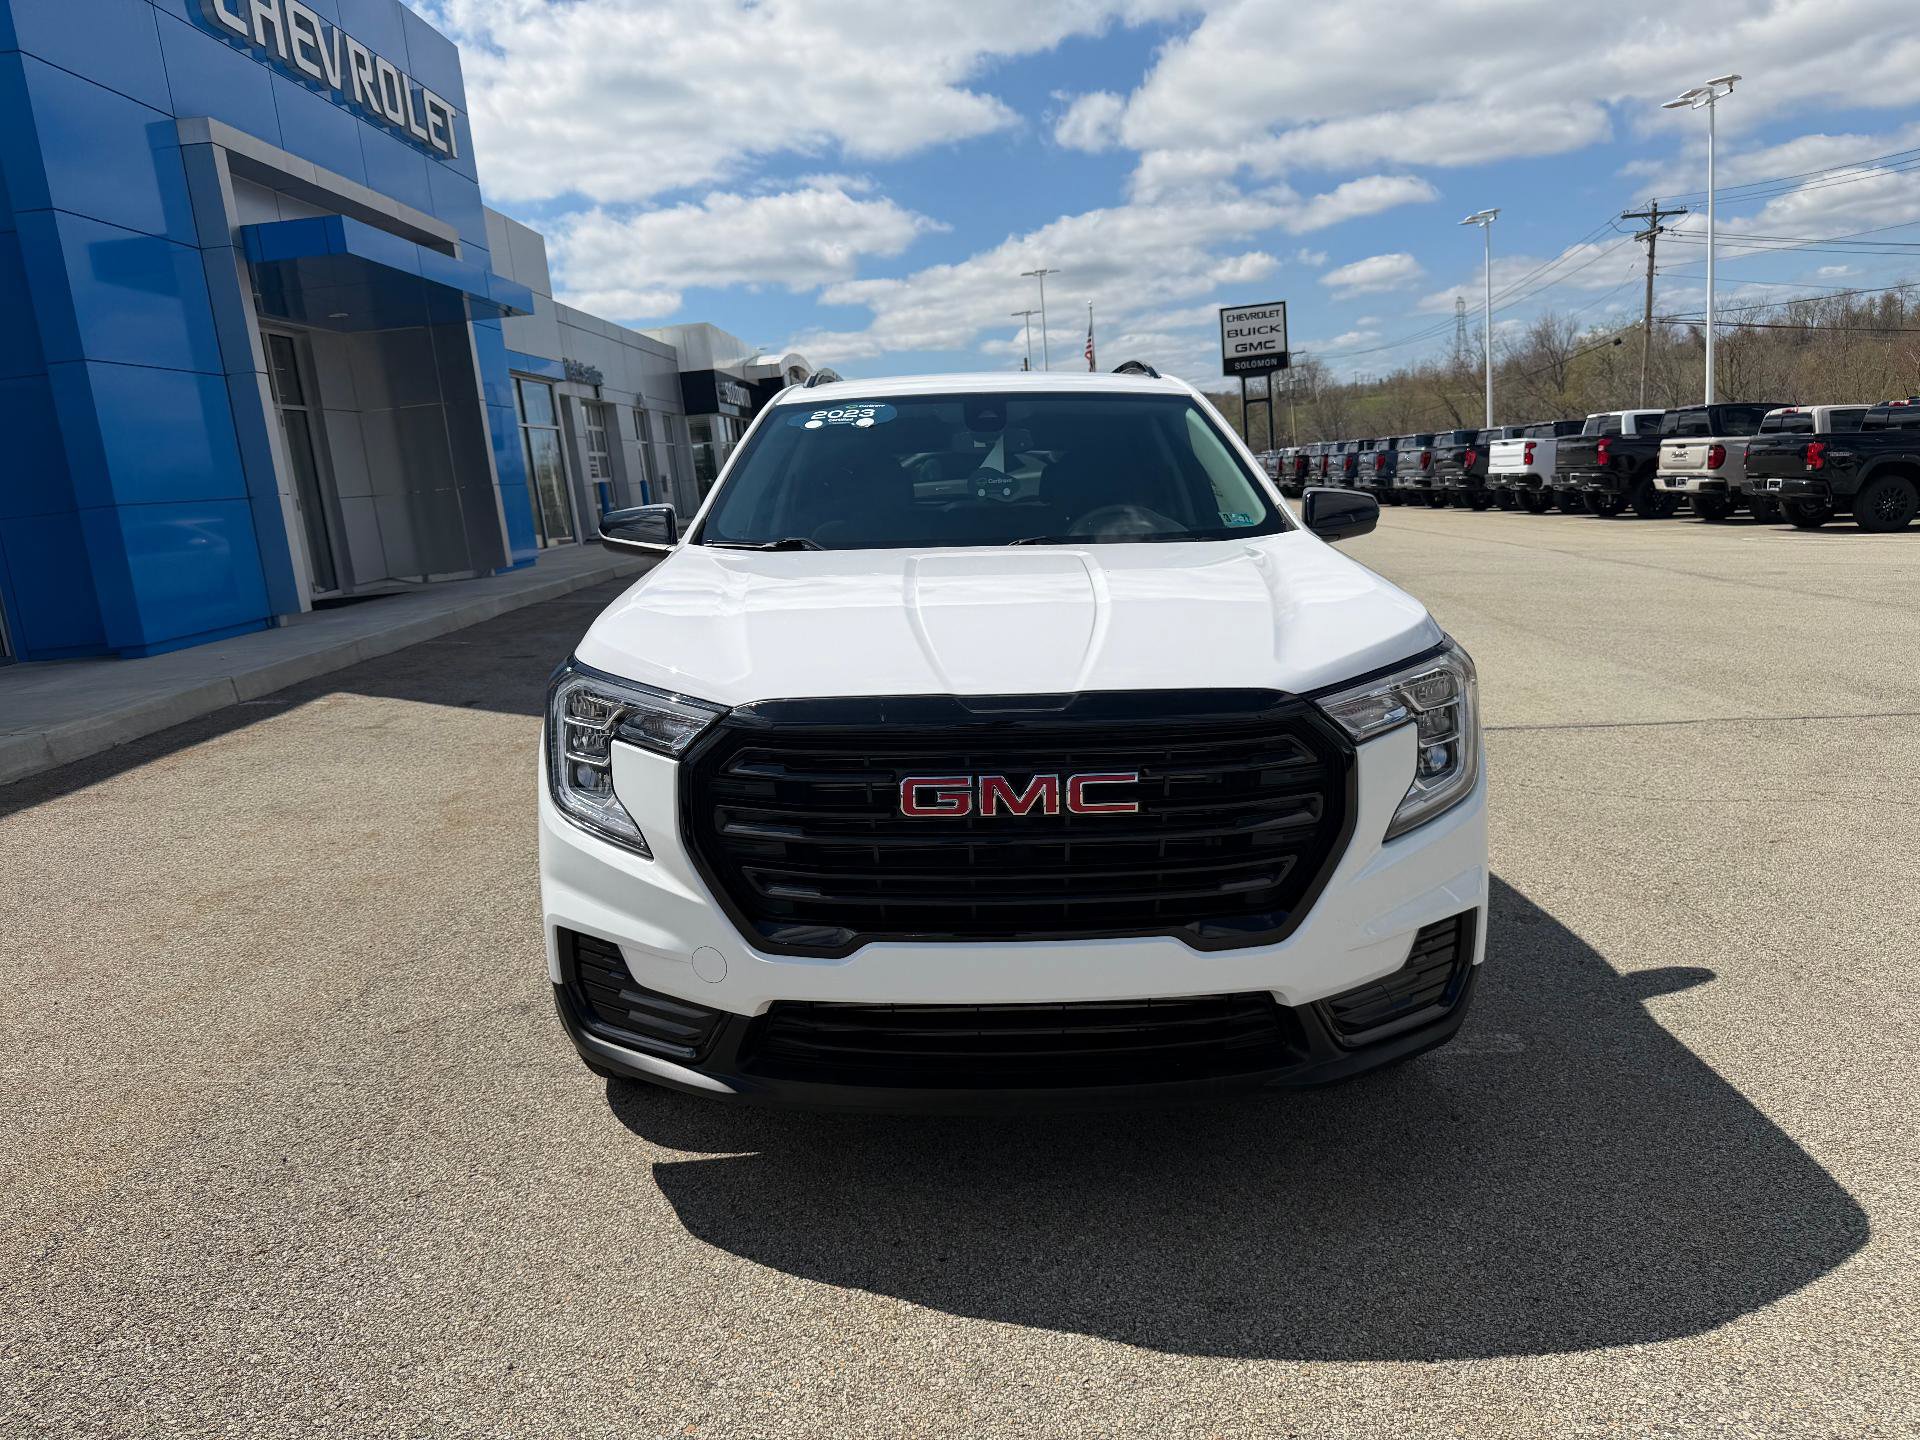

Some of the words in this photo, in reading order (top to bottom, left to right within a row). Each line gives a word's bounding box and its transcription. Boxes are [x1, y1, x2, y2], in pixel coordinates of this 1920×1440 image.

[1226, 309, 1281, 323] CHEVROLET
[1227, 324, 1281, 338] BUICK
[1235, 339, 1276, 353] GMC
[1234, 358, 1277, 370] SOLOMON
[811, 408, 876, 420] 2023
[899, 771, 1139, 817] GMC
